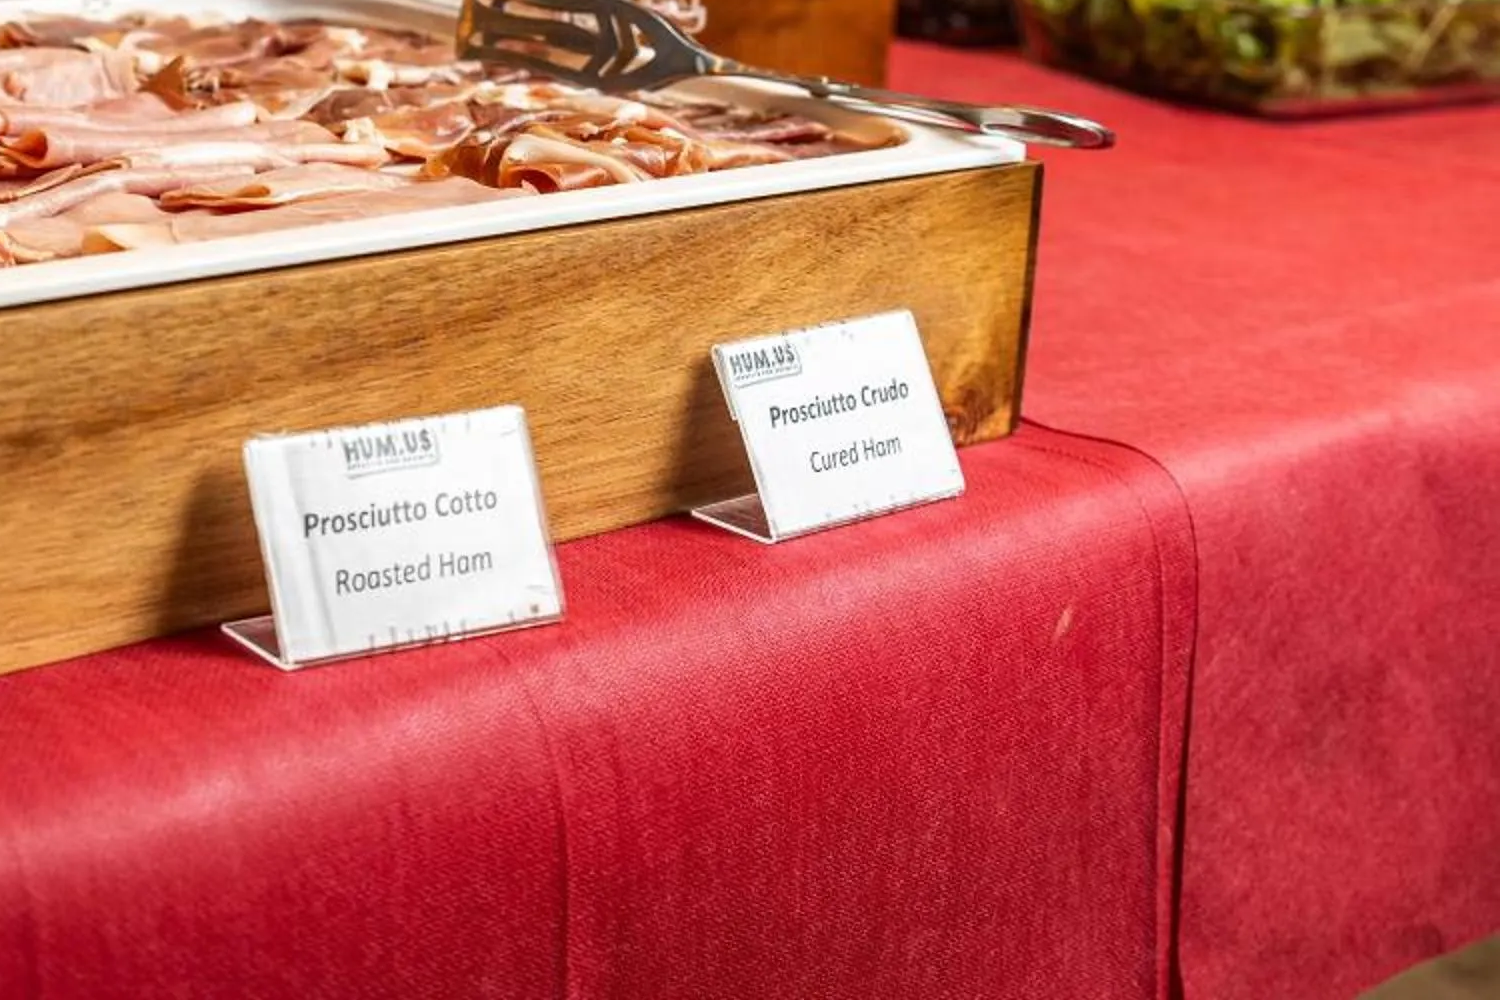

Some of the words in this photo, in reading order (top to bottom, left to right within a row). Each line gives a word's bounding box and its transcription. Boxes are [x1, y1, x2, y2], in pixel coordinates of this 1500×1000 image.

[730, 344, 795, 376] HUM.US
[769, 390, 857, 428] Prosciutto
[860, 378, 909, 407] Crudo
[343, 428, 432, 463] HUM.US
[809, 440, 859, 473] Cured
[862, 435, 902, 460] Ham
[304, 498, 427, 537] Prosciutto
[435, 488, 497, 518] Cotto
[336, 554, 431, 596] Roasted
[439, 551, 493, 580] Ham
